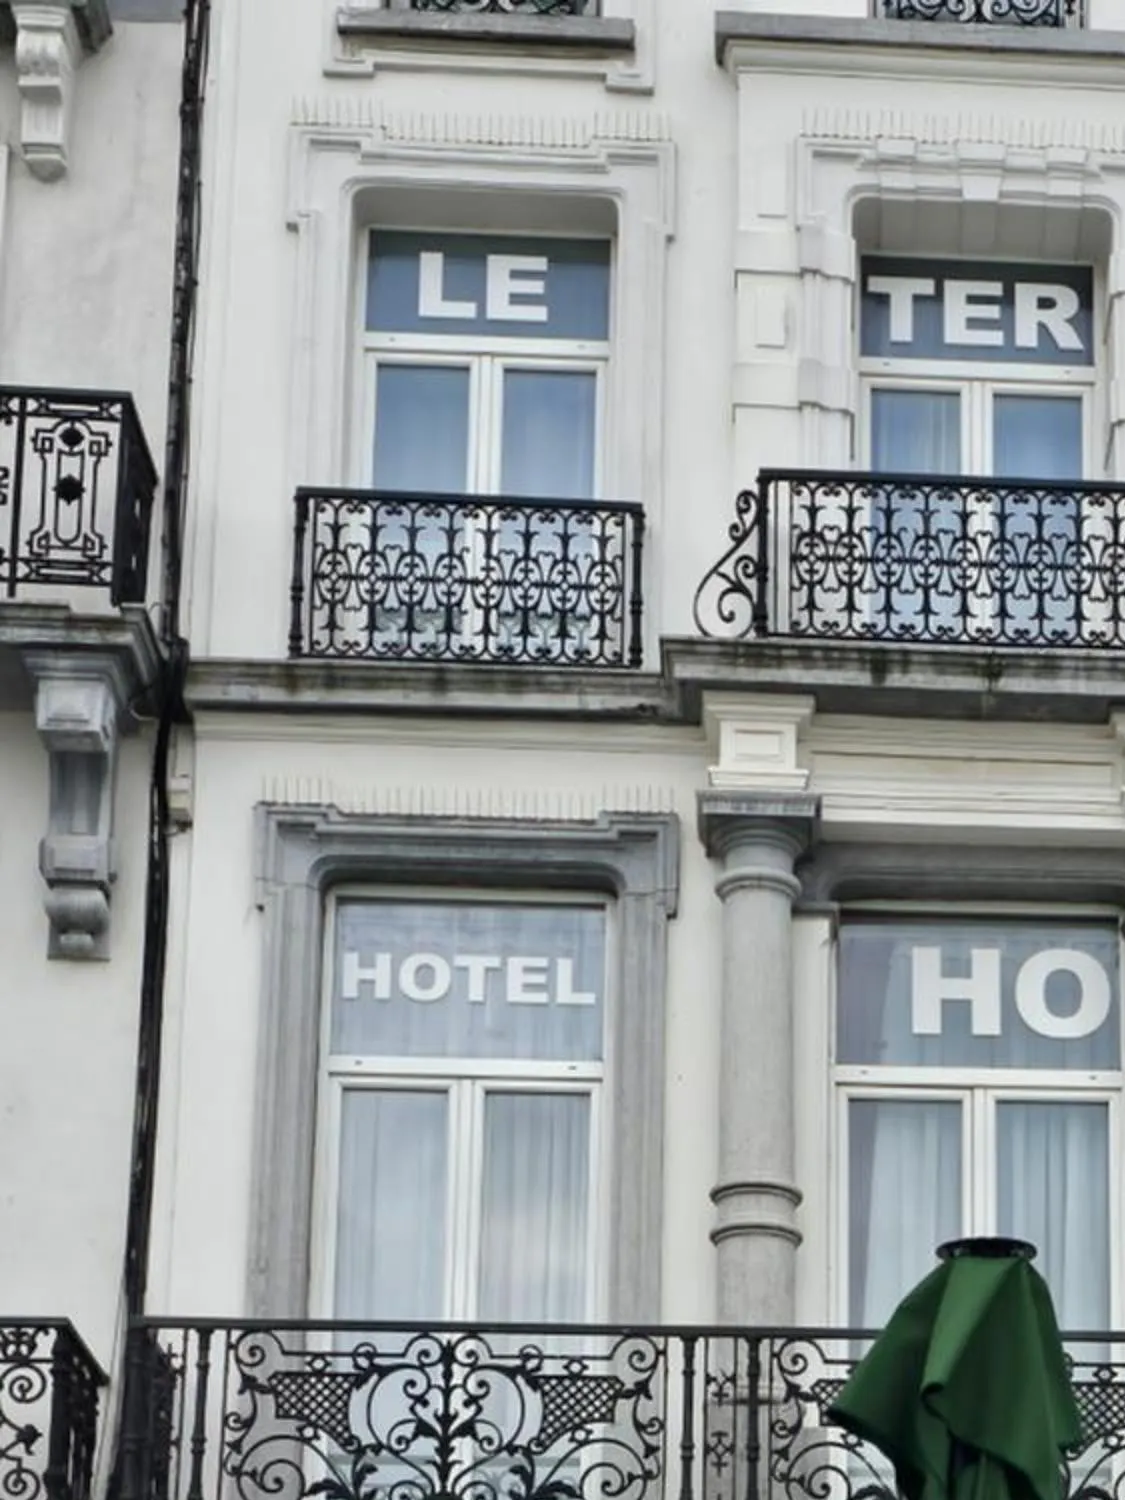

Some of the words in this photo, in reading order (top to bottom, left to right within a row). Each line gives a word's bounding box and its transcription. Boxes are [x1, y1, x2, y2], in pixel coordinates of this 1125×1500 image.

[416, 251, 549, 323] LE
[866, 276, 1085, 351] TER
[341, 951, 597, 1006] HOTEL
[910, 945, 1112, 1040] HO
